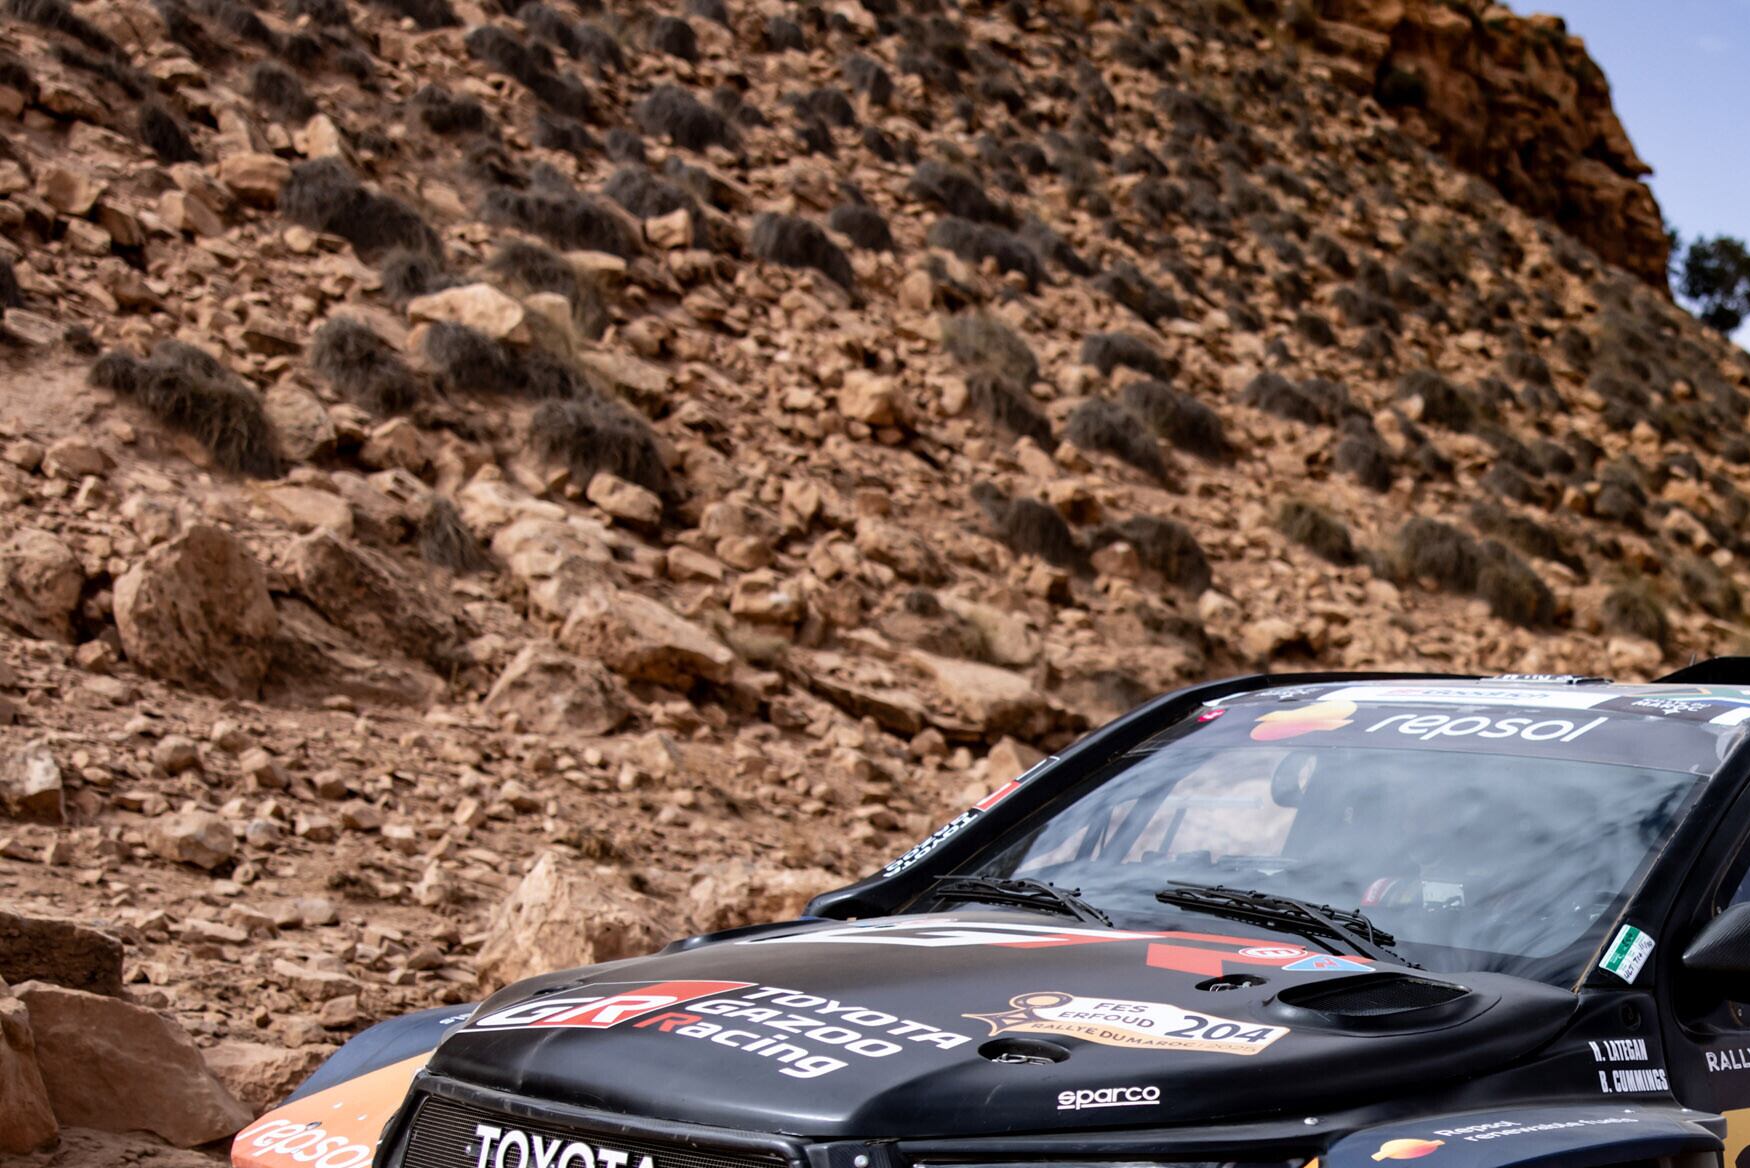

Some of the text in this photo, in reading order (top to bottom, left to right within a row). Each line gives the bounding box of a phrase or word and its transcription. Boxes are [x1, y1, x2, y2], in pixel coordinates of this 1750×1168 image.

[1366, 713, 1608, 742] repsol
[476, 994, 679, 1029] GR
[742, 986, 972, 1050] TOYOTA
[1058, 1011, 1155, 1029] ERFOUD
[1093, 1001, 1150, 1013] FES
[685, 999, 903, 1057] GAZOO
[1031, 1022, 1097, 1035] RALLYE
[1099, 1030, 1126, 1042] DU
[1127, 1036, 1196, 1048] MAROC
[1164, 1015, 1275, 1043] 204
[633, 1012, 849, 1079] Racing
[1603, 1038, 1649, 1061] LATEGAN
[1598, 1068, 1669, 1093] B. CUMMINGS
[1057, 1085, 1160, 1110] sparco
